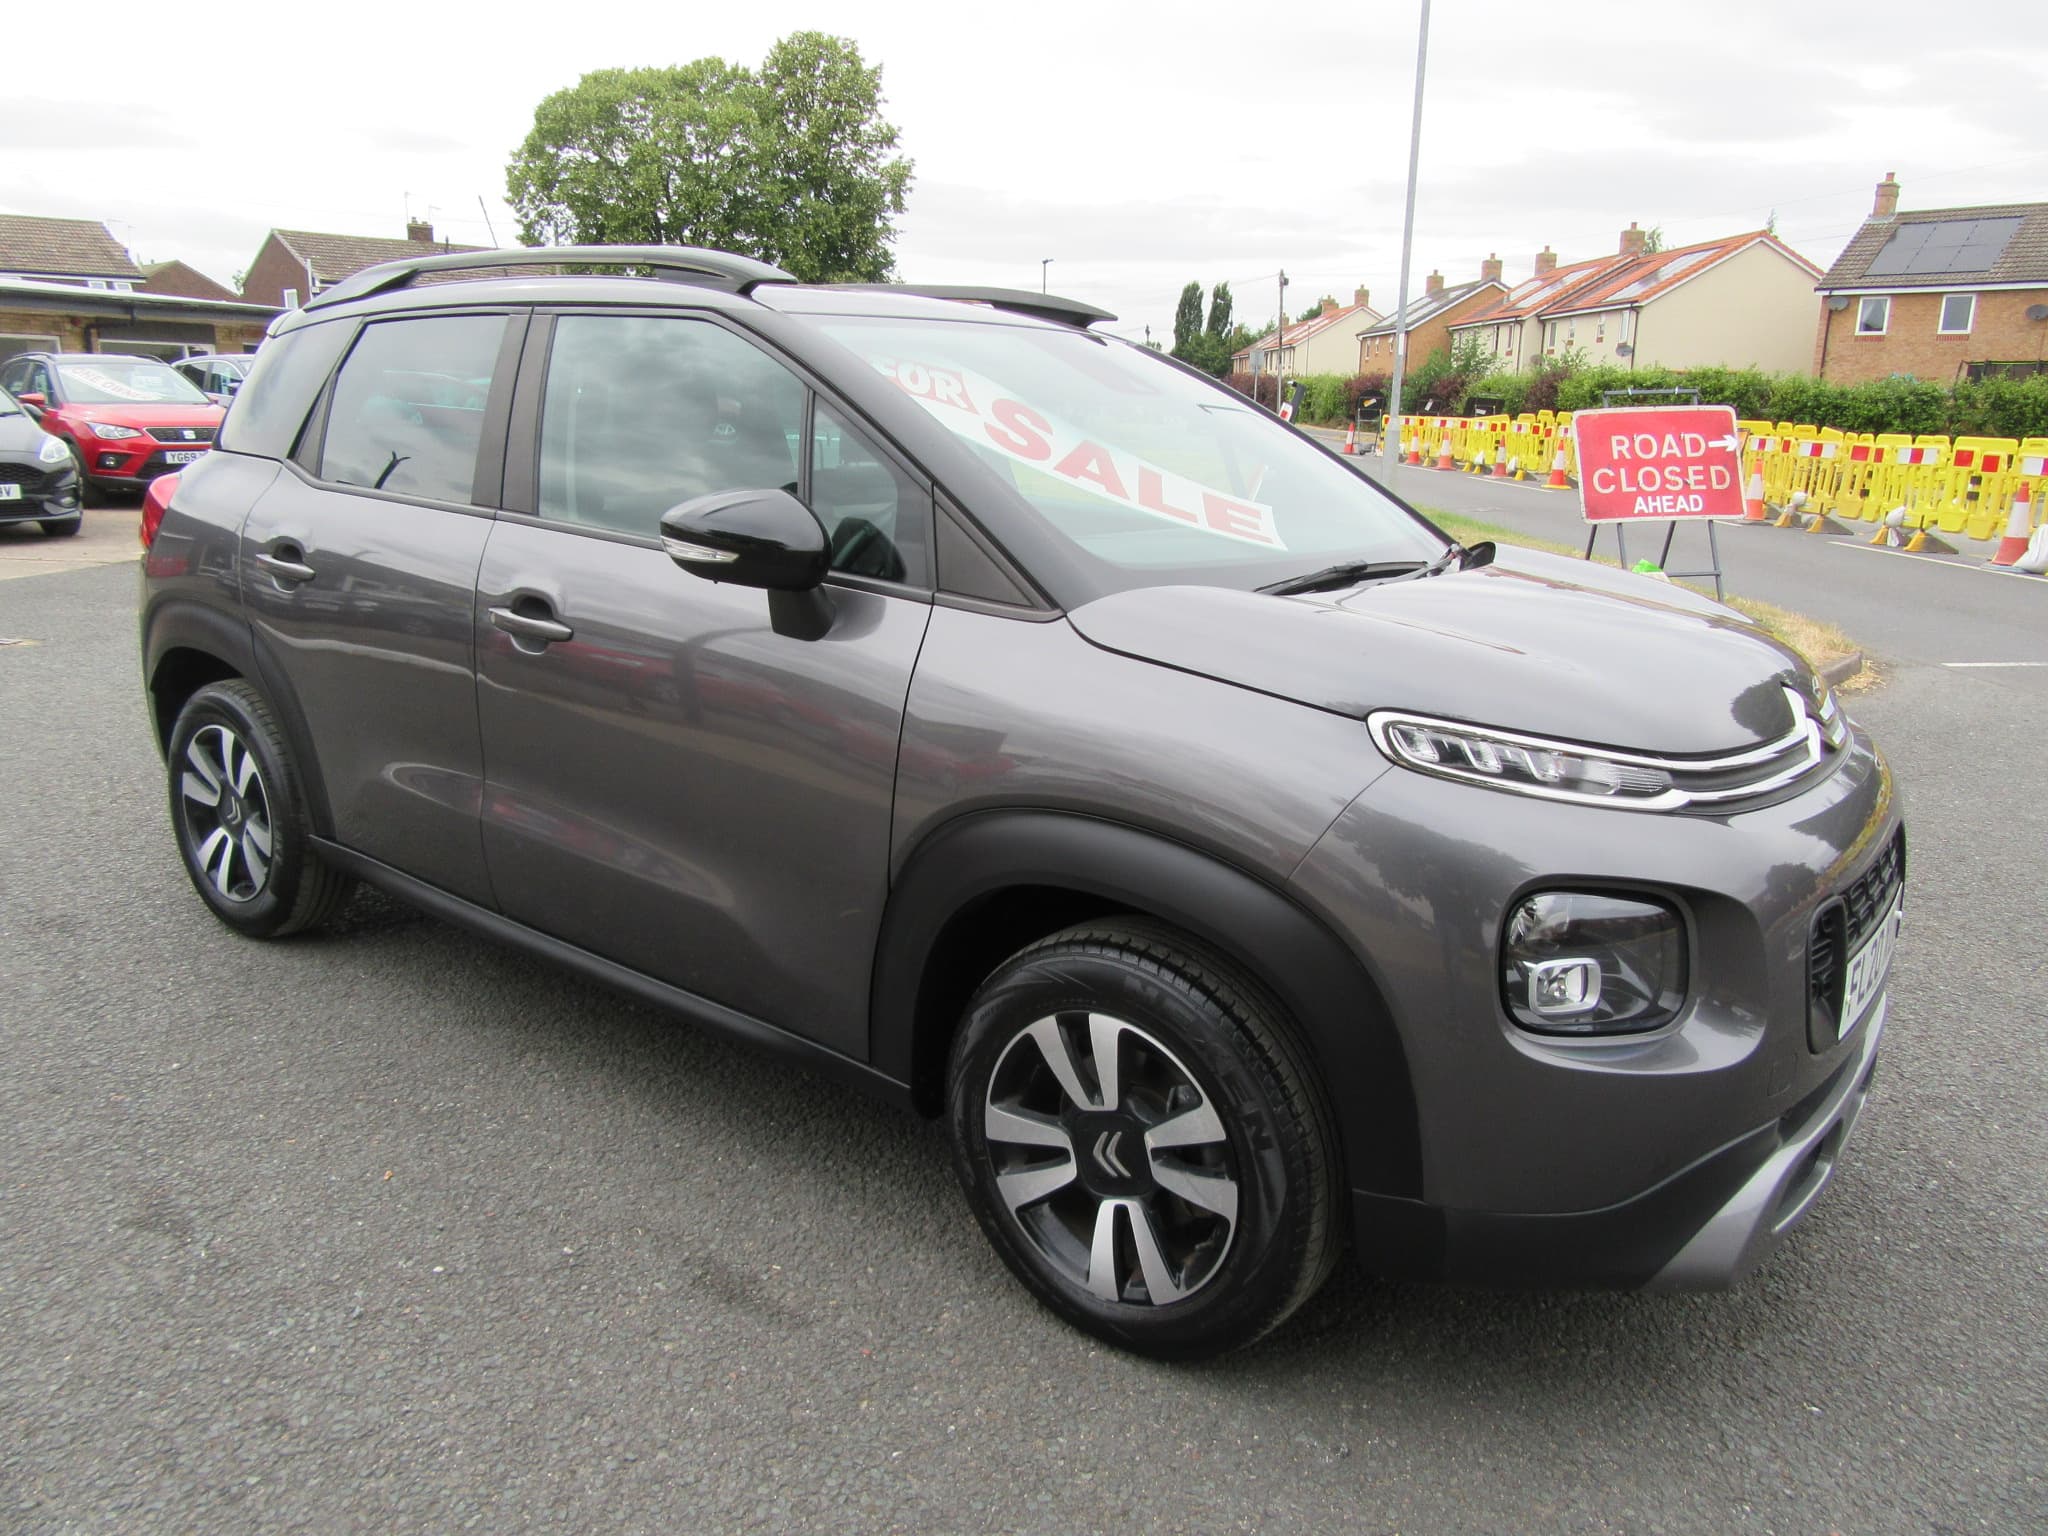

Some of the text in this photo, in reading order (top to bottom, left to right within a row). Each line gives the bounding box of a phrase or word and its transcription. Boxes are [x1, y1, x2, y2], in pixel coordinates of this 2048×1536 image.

[1611, 433, 1706, 460] ROAD
[984, 397, 1274, 545] SALE
[1593, 465, 1731, 494] CLOSED
[1634, 495, 1704, 514] AHEAD
